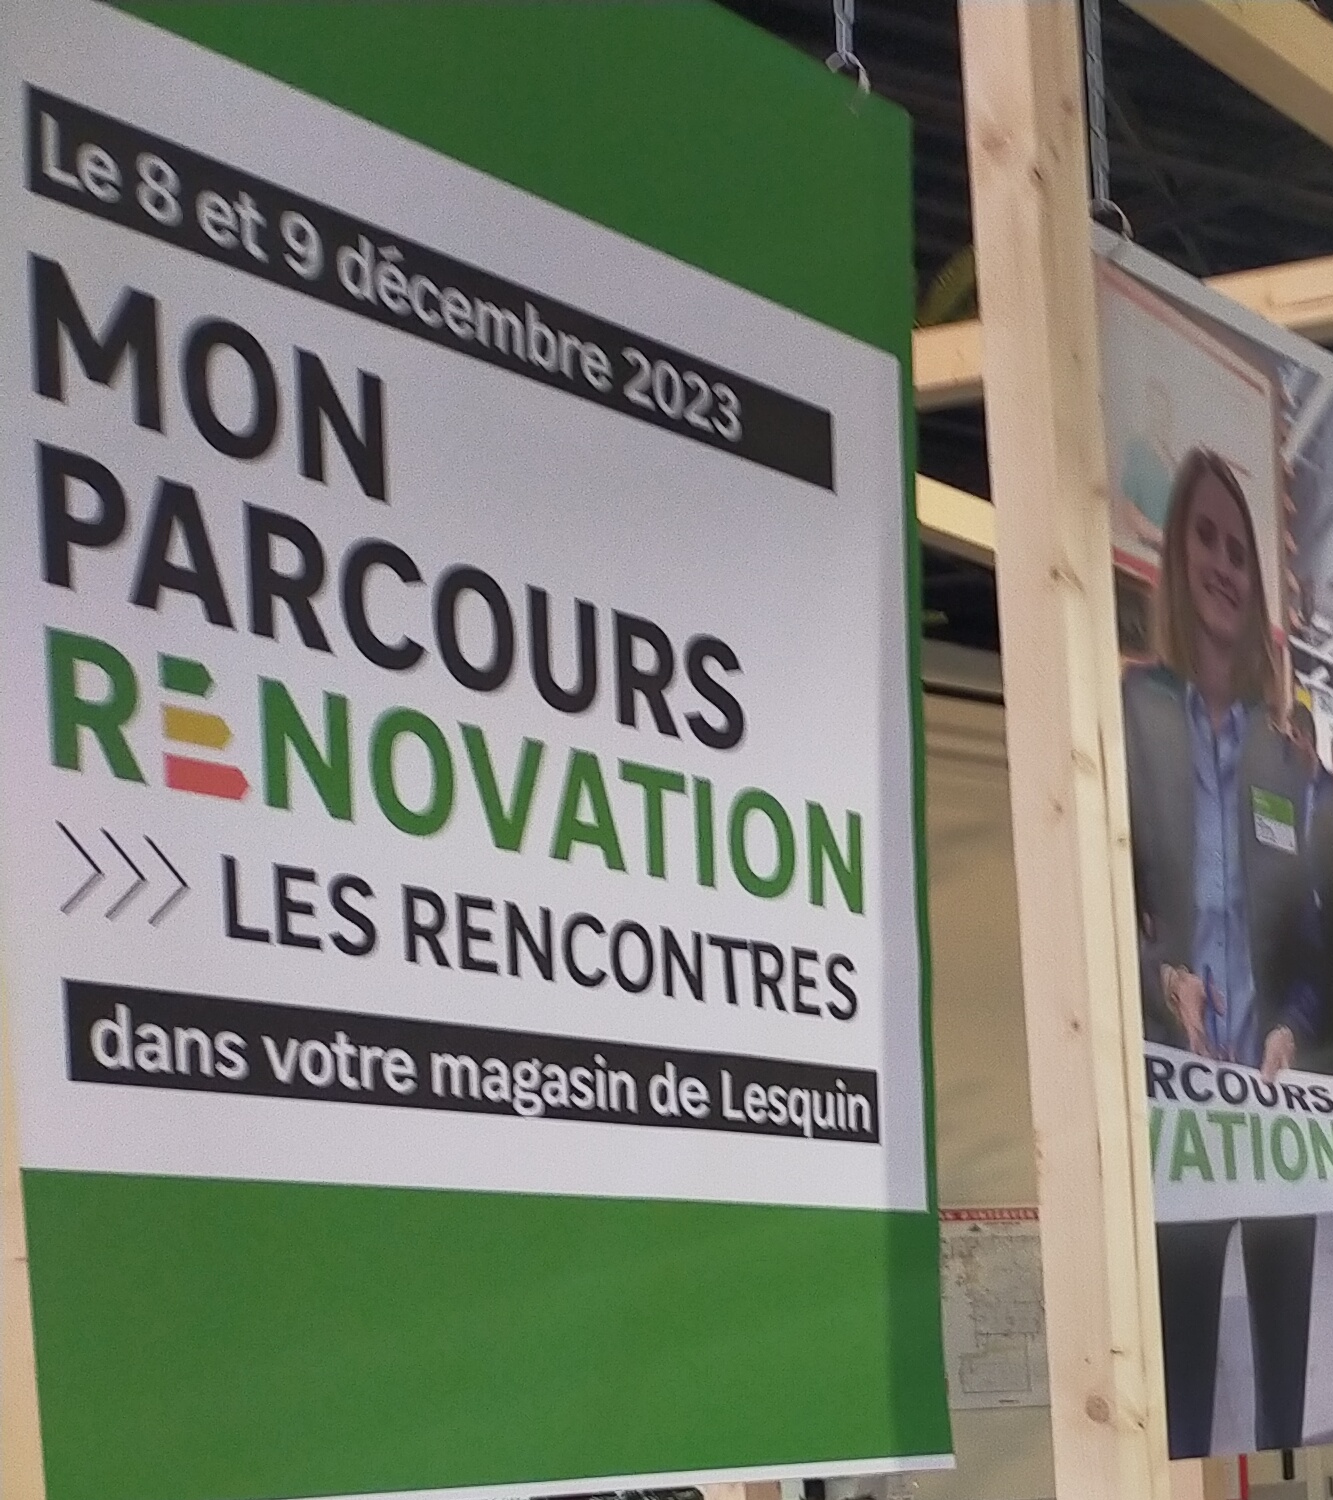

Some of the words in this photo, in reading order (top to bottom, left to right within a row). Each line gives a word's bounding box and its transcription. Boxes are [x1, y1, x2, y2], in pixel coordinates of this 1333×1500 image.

[27, 251, 389, 504] MON
[39, 111, 121, 201] Le
[135, 153, 185, 227] 8
[197, 183, 267, 263] et
[281, 210, 323, 282] 9
[338, 234, 612, 394] décembre
[622, 347, 744, 445] 2023
[35, 437, 745, 748] PARCOURS
[221, 853, 377, 957] LES
[402, 883, 859, 1022] RENCONTRES
[89, 1004, 249, 1081] dans
[261, 1029, 417, 1095] votre
[430, 1051, 638, 1117] magasin
[648, 1060, 710, 1119] de
[720, 1067, 873, 1137] Lesquin
